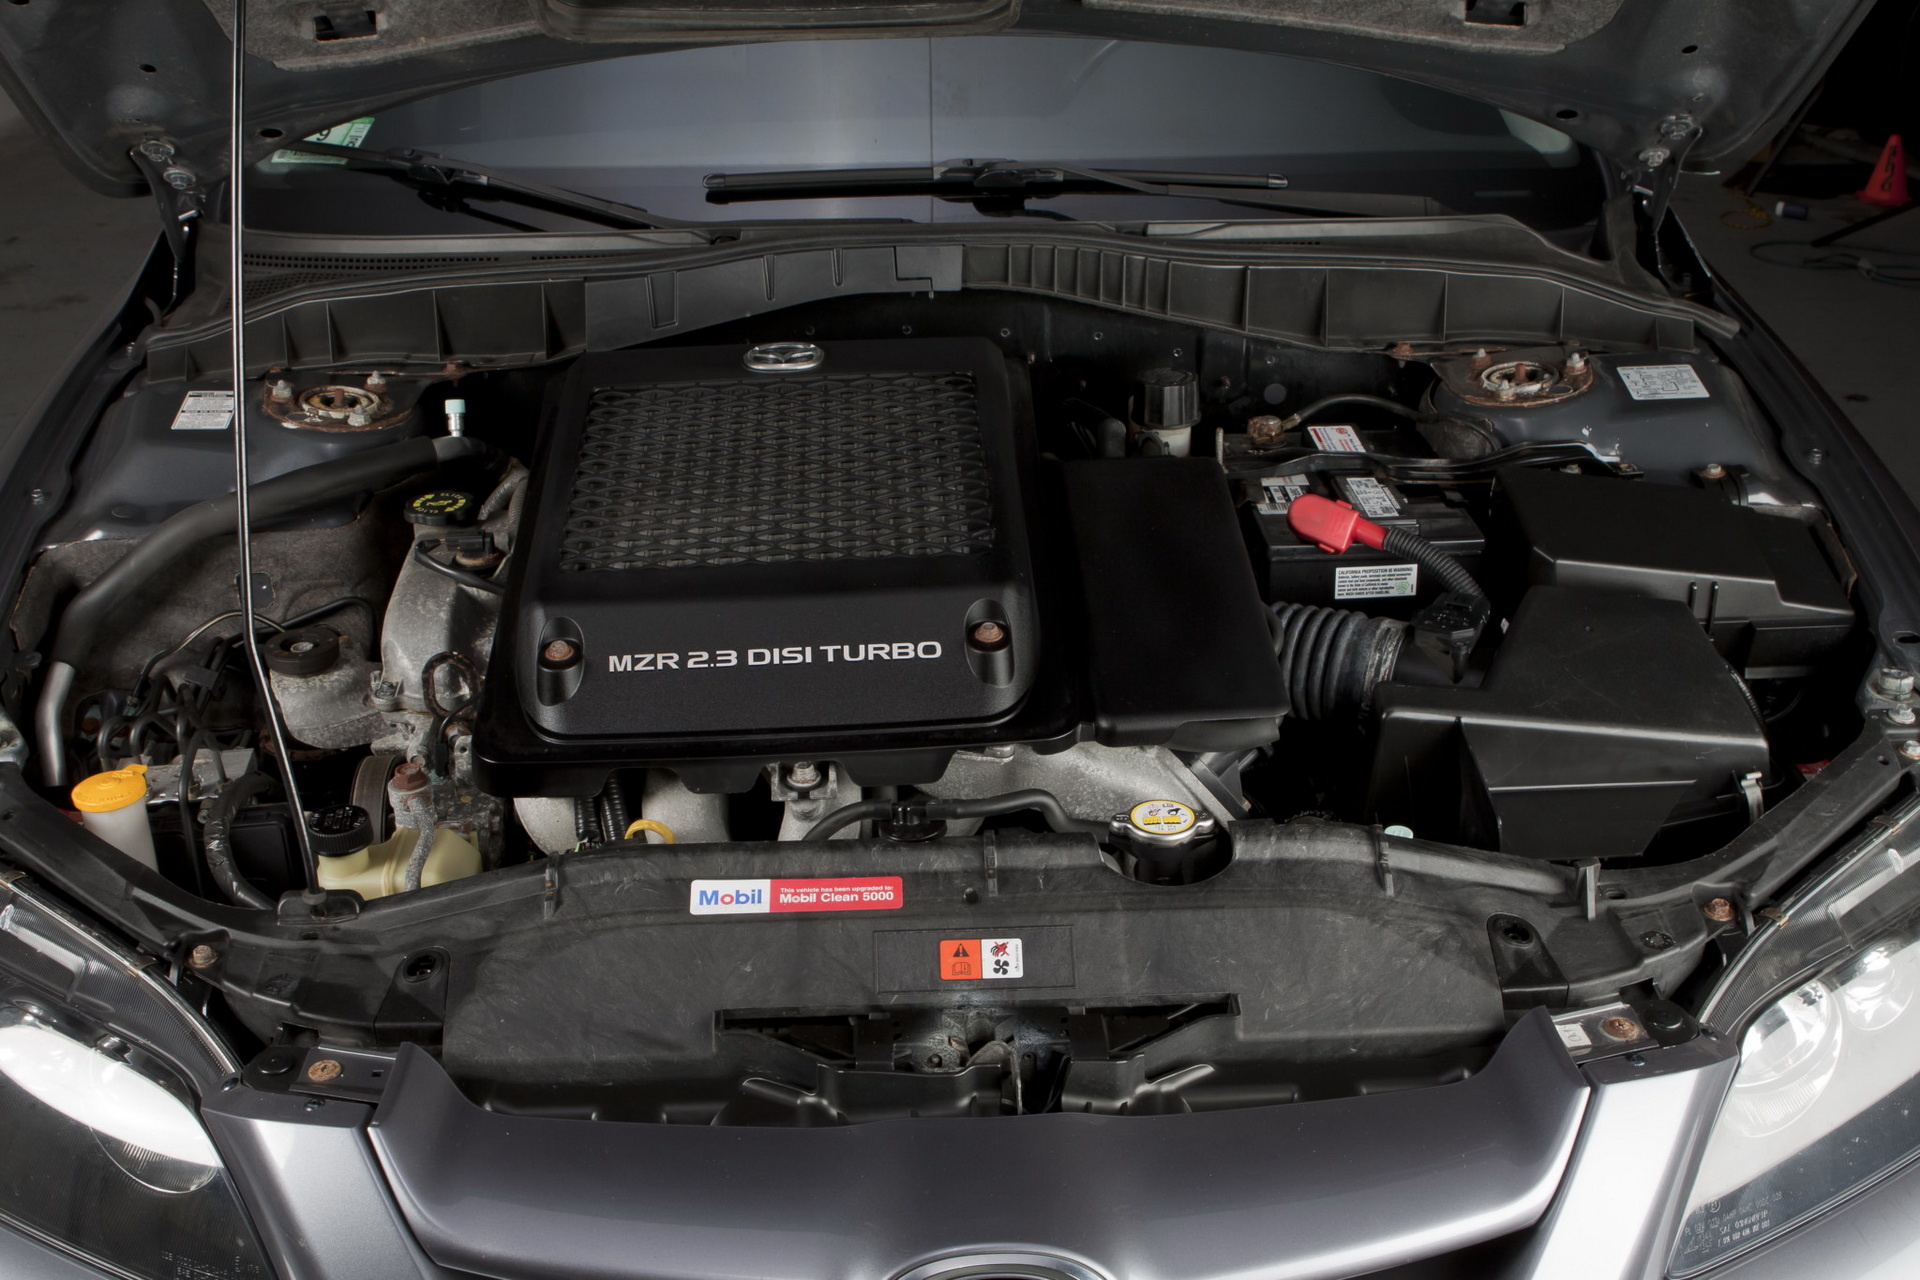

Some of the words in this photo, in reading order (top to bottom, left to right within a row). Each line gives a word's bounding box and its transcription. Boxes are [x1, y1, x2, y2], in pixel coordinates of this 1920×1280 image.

[609, 653, 678, 672] MZR
[687, 650, 738, 669] 2.3
[748, 647, 812, 666] DISI
[820, 641, 942, 662] TURBO
[699, 889, 762, 905] Mobil
[780, 894, 816, 903] Mobil
[821, 892, 859, 902] Clean
[863, 891, 894, 901] 5000
